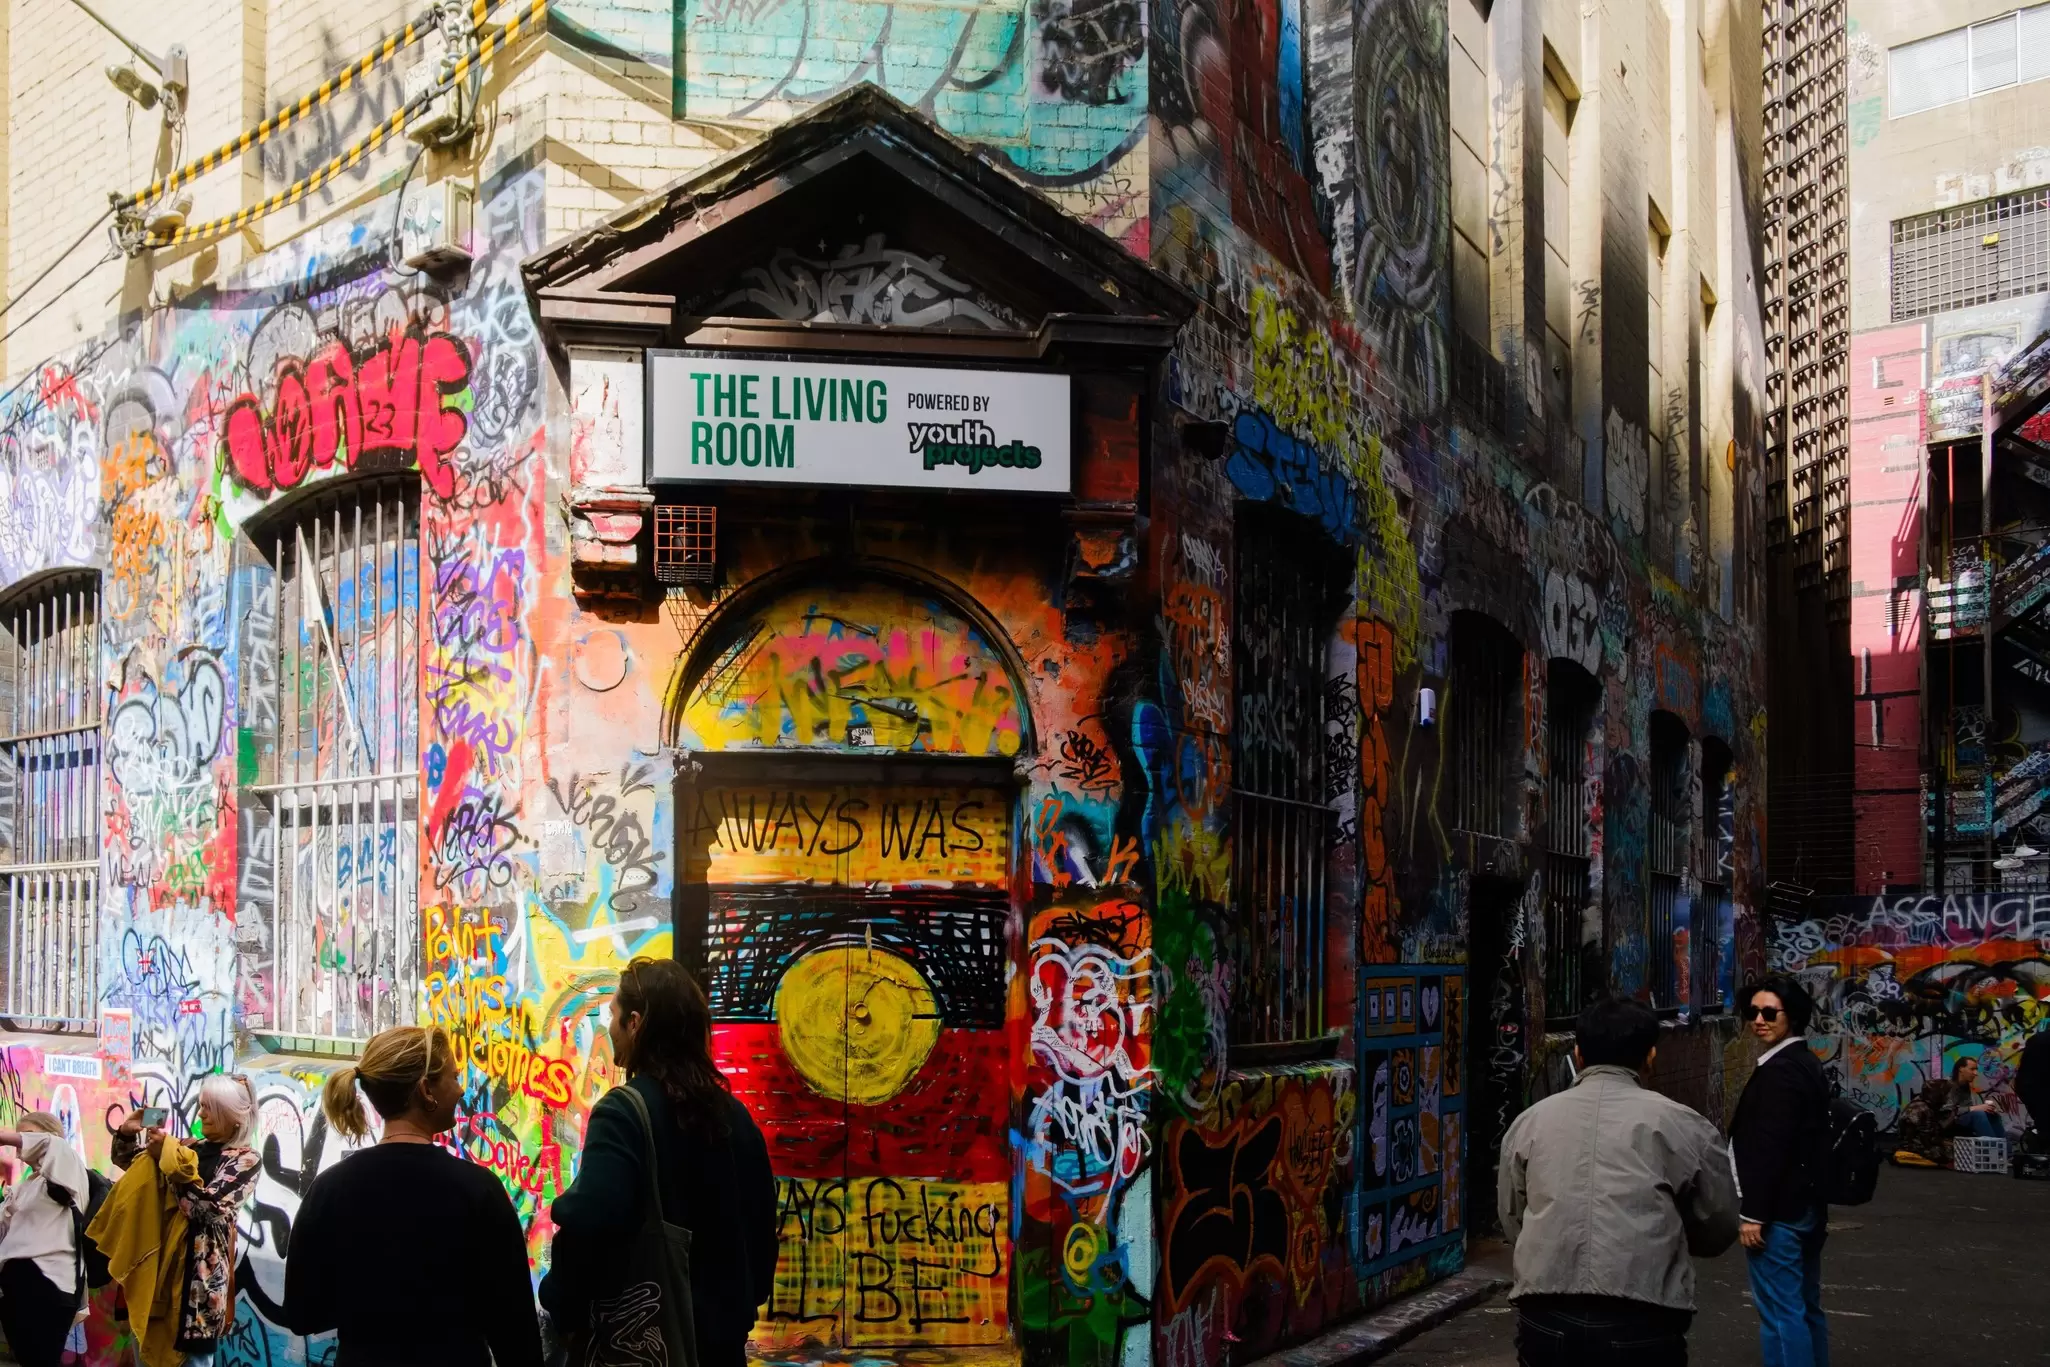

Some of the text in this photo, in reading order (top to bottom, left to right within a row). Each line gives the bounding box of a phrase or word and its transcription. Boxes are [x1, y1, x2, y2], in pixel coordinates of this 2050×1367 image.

[690, 373, 888, 424] THE LIVING
[908, 393, 990, 412] POWERED BY
[691, 421, 795, 468] ROOM
[908, 419, 1042, 474] youth projects
[880, 797, 985, 861] WAS
[424, 904, 502, 963] Paint
[1867, 893, 2050, 942] ASSANGE
[424, 964, 507, 1024] Ruins
[861, 1177, 1001, 1278] fucking
[850, 1252, 971, 1333] BE
